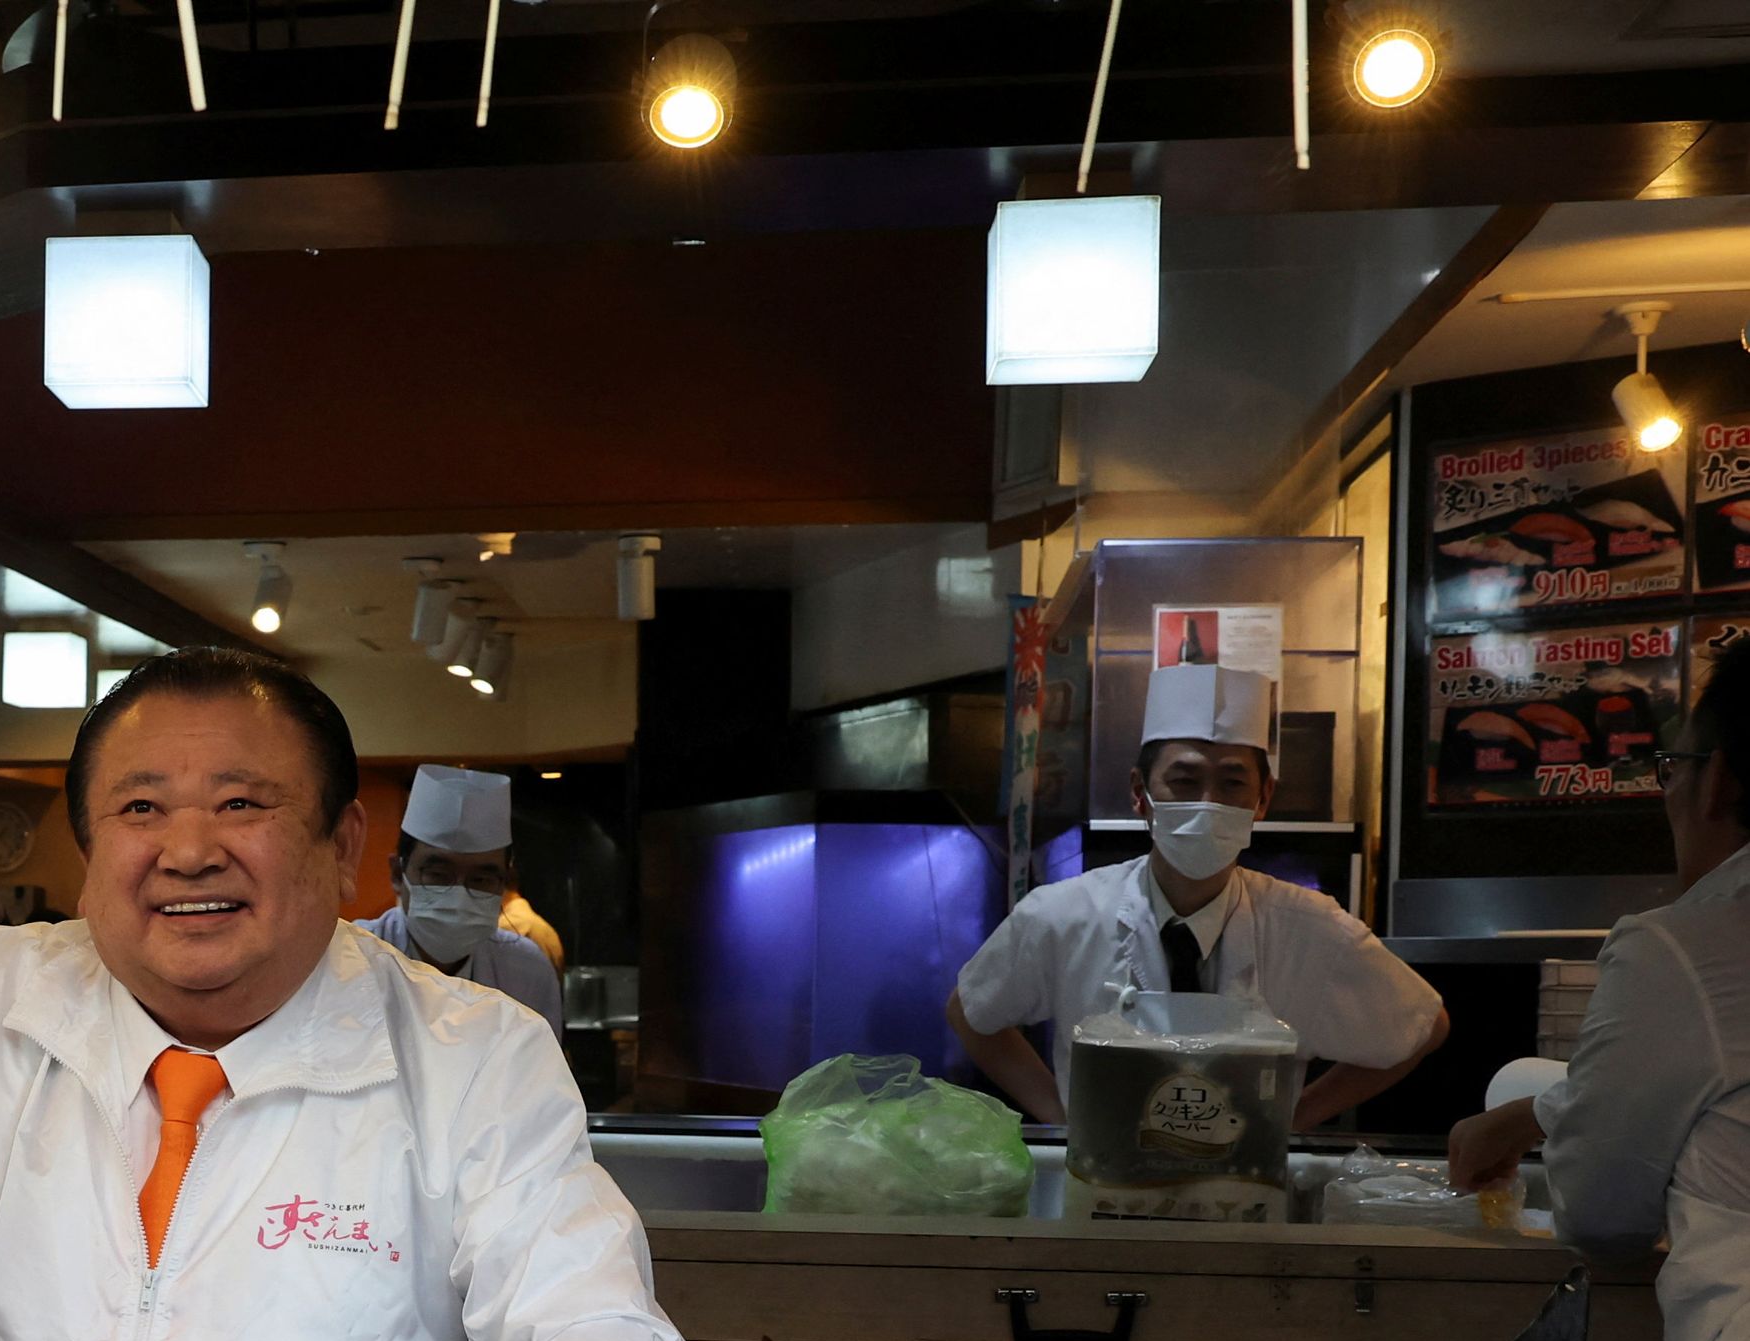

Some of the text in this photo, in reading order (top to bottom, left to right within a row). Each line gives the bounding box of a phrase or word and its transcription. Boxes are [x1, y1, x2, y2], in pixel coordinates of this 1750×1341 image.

[1442, 448, 1524, 479] Broiled
[1533, 569, 1610, 600] 910円
[1533, 637, 1622, 664] Tasting
[1631, 629, 1674, 657] Set
[1535, 765, 1613, 795] 773円
[1170, 1087, 1207, 1103] エコ
[1153, 1101, 1225, 1120] クッキング
[308, 1243, 369, 1254] SUSHIZANMAI
